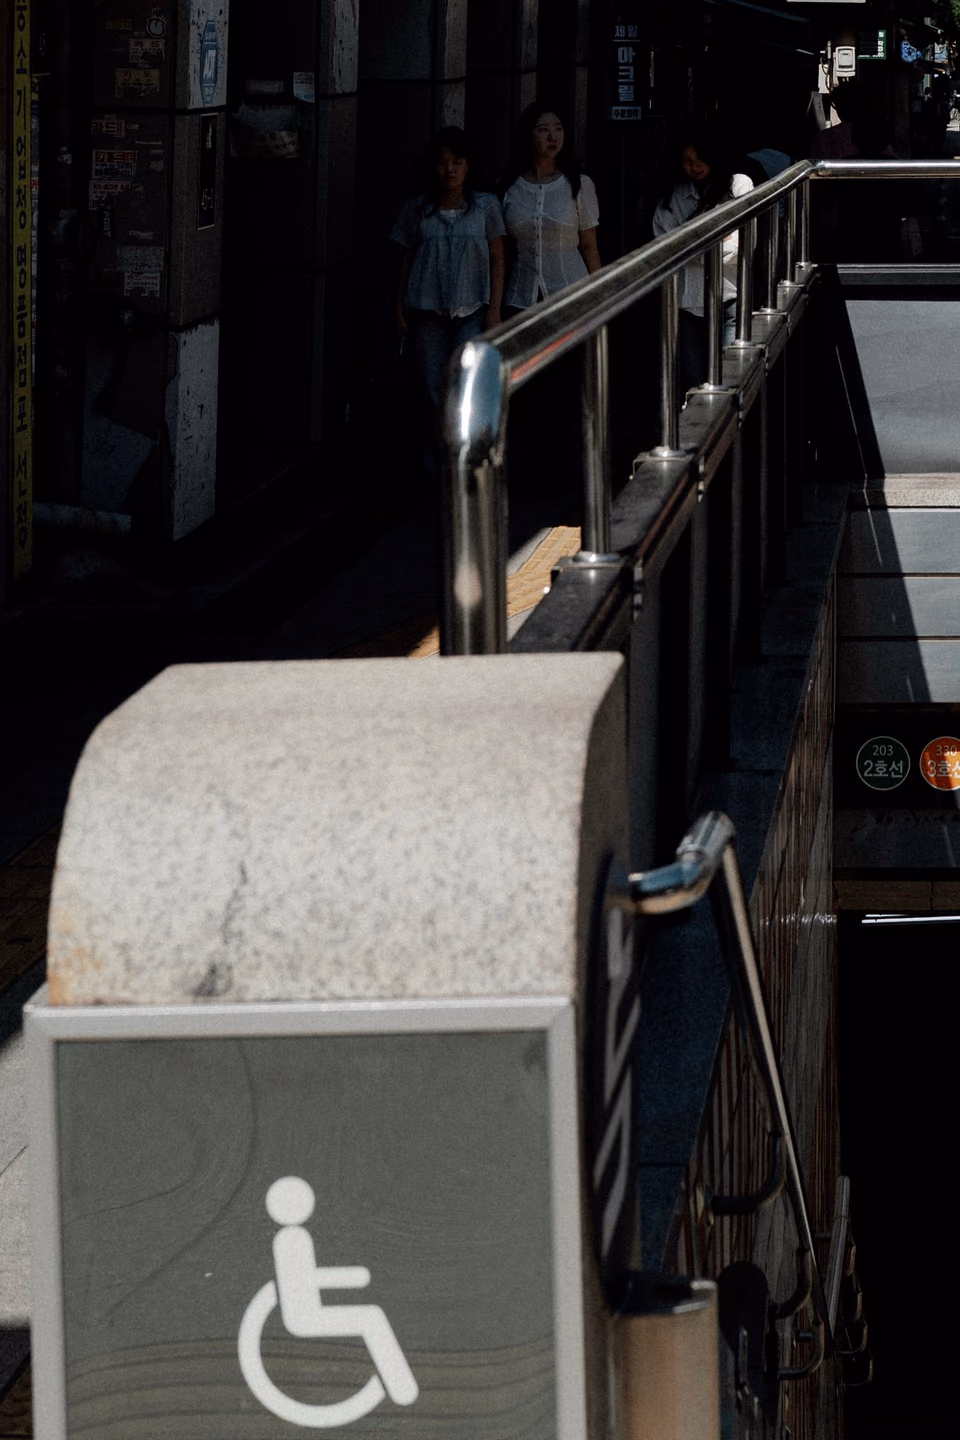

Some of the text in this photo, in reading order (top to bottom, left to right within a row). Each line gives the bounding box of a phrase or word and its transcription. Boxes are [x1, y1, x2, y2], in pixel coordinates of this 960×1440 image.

[617, 46, 636, 102] 아크릴
[15, 244, 28, 433] 명품점포
[872, 745, 895, 757] 203
[936, 745, 958, 757] 330
[863, 760, 904, 778] 2호선
